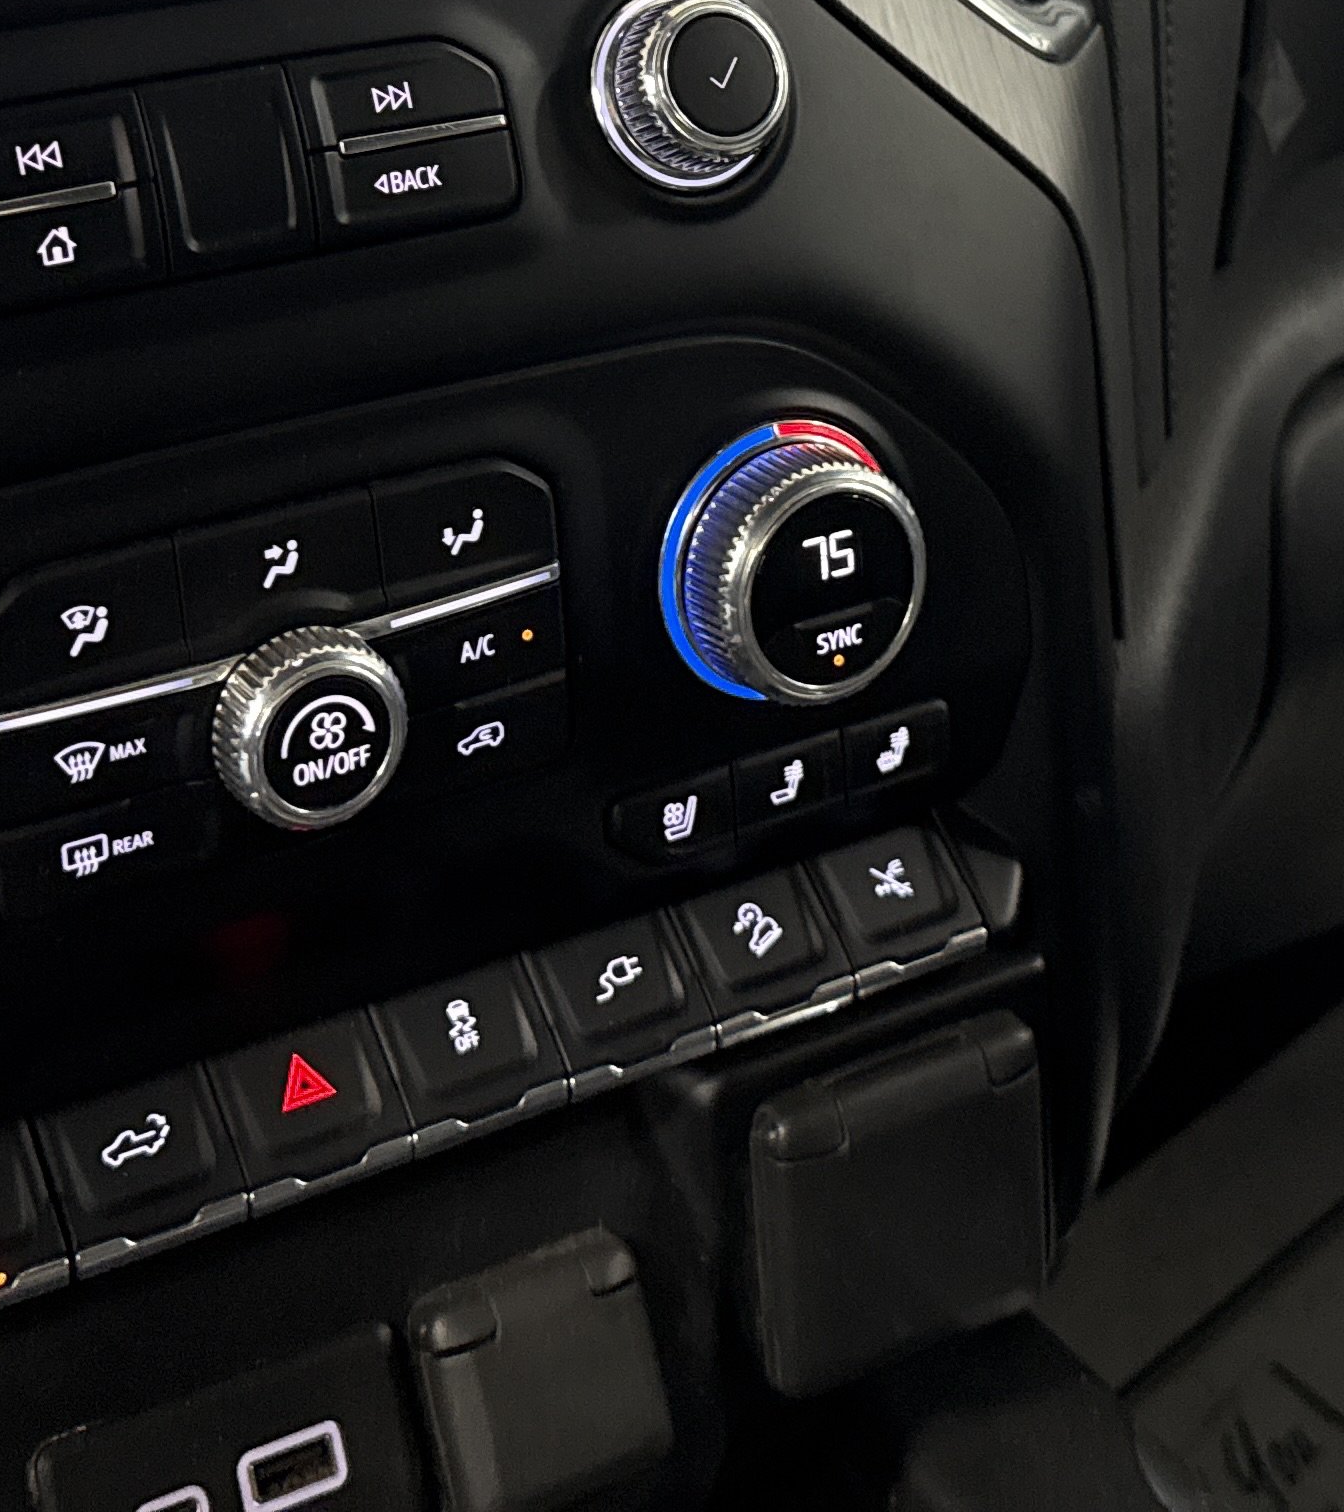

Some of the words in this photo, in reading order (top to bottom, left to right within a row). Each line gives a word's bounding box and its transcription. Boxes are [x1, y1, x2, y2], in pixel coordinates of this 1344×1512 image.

[391, 165, 443, 193] BACK
[801, 529, 855, 581] 75
[460, 633, 496, 664] A/C
[817, 623, 862, 657] SYNC
[109, 737, 147, 762] MAX
[292, 744, 372, 787] ON/OFF
[111, 830, 155, 856] REAR
